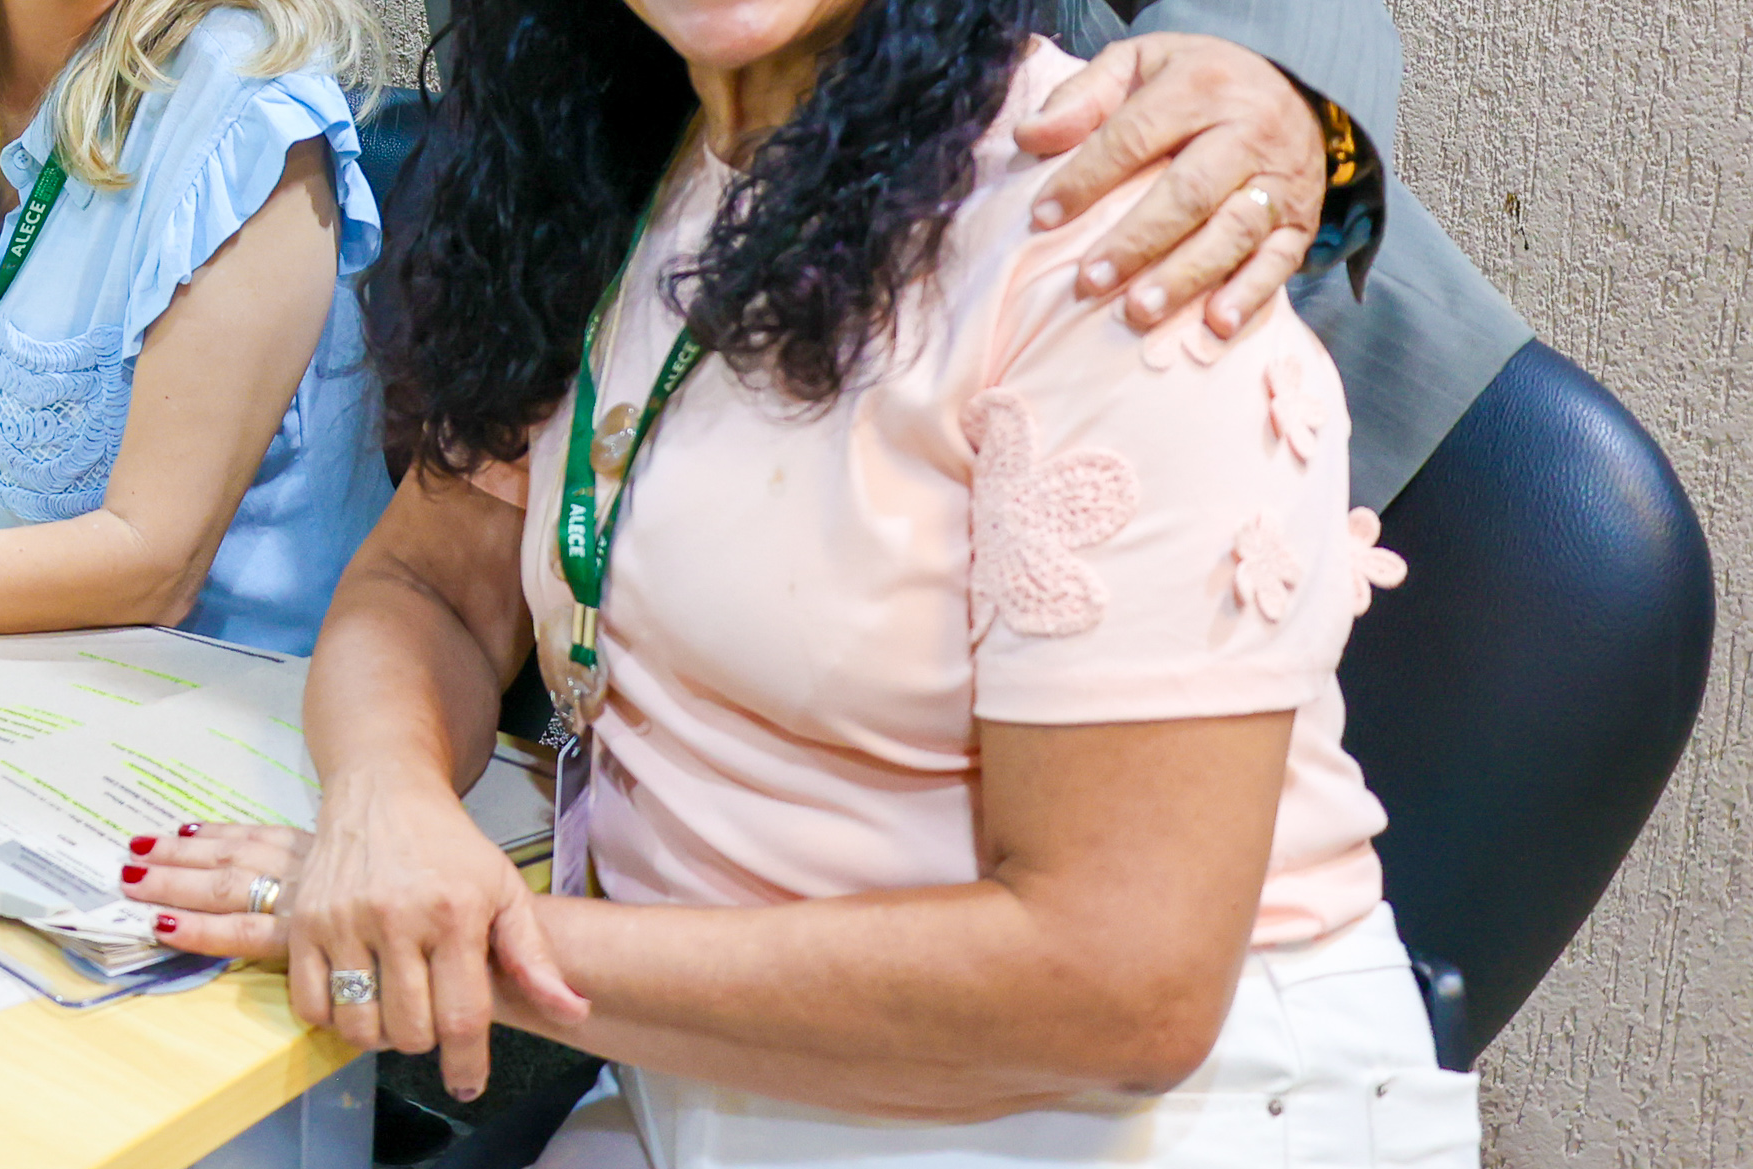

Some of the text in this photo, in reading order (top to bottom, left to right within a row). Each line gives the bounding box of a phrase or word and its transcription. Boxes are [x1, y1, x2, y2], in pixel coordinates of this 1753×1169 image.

[10, 200, 47, 257] ALECE
[663, 340, 701, 392] ALECE
[568, 503, 586, 558] ALECE
